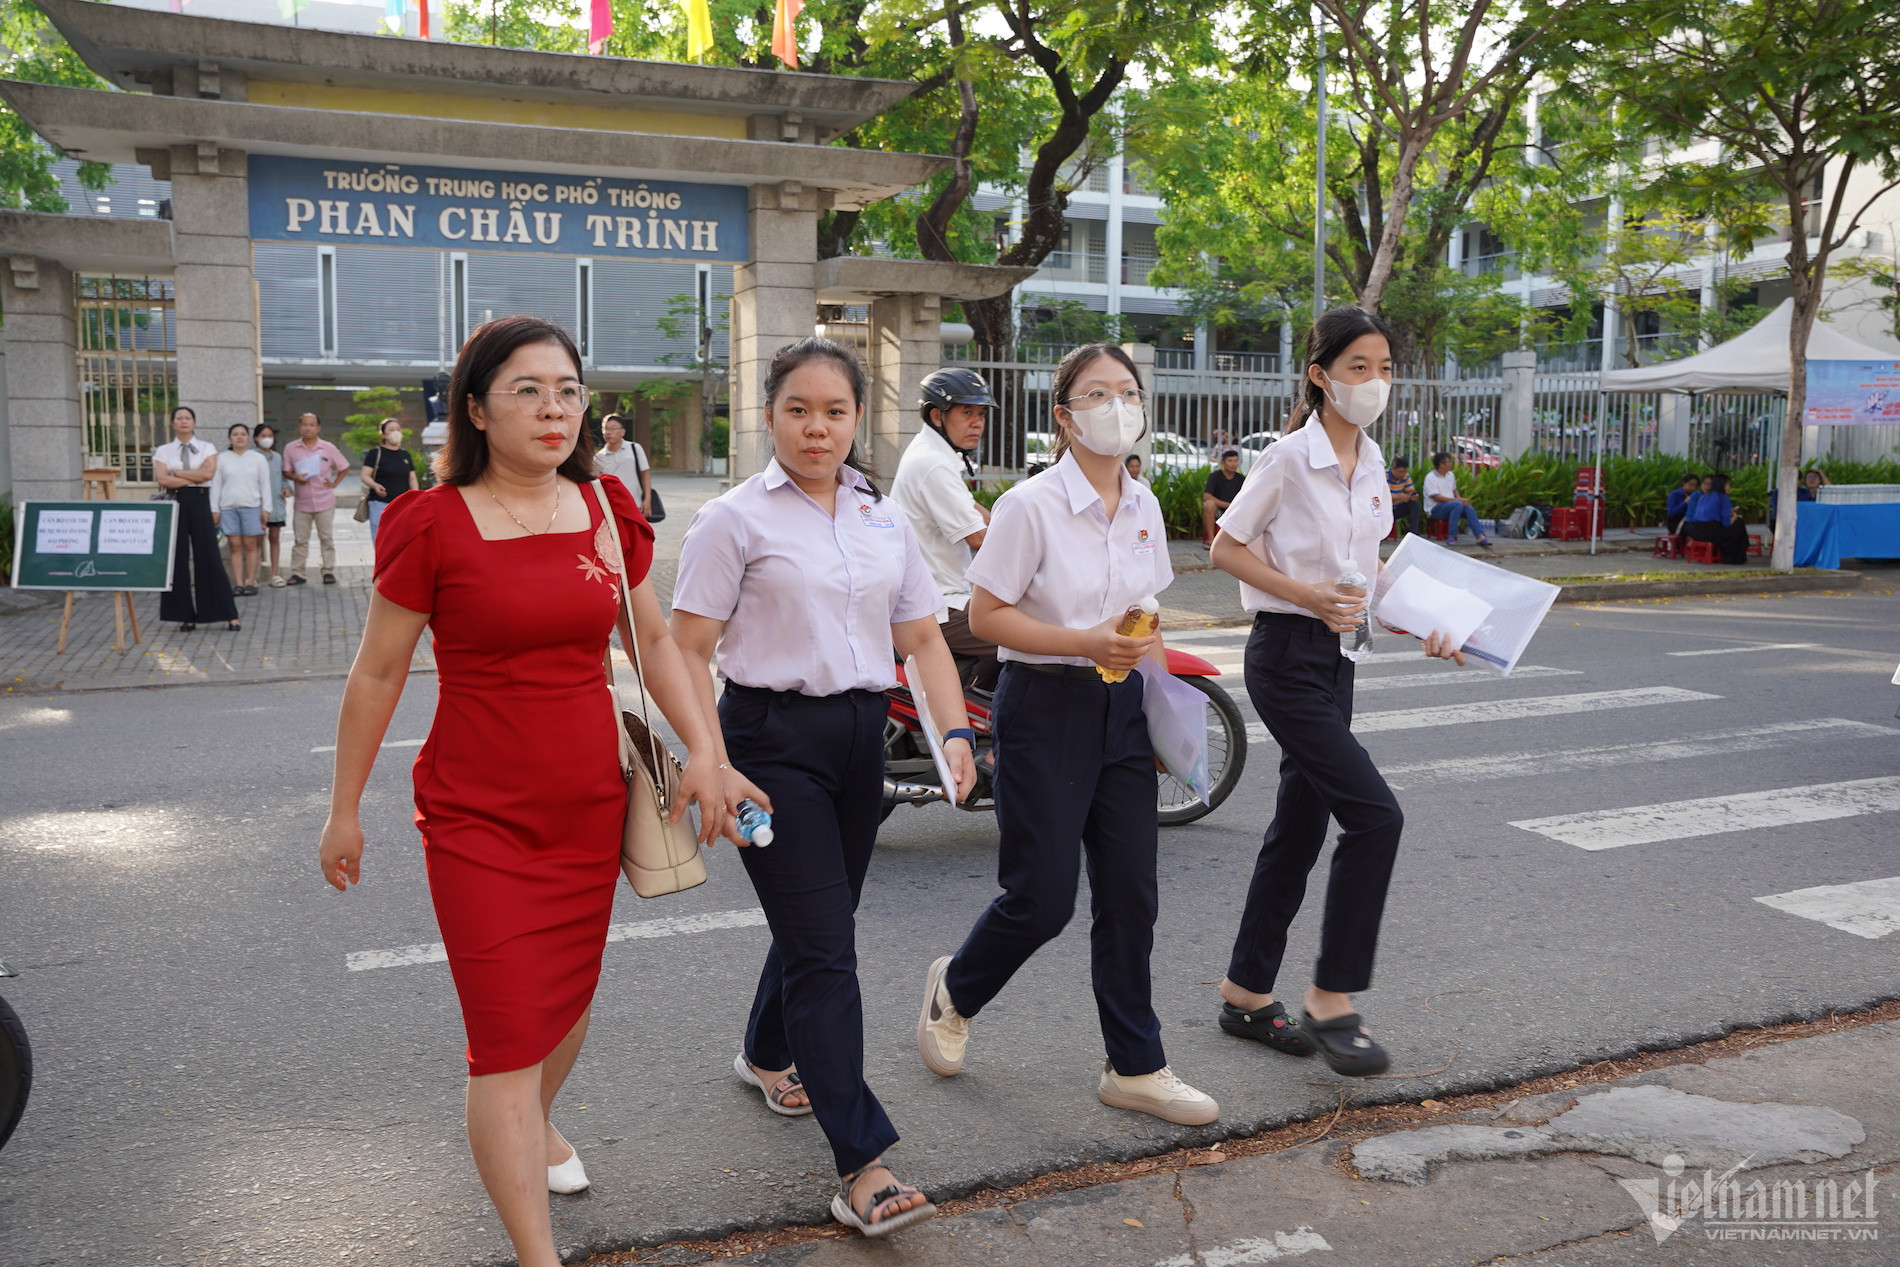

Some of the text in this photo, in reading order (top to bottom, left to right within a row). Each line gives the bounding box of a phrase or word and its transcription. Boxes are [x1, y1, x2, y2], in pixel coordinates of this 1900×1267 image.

[323, 165, 682, 210] TRƯỜNG TRUNG HỌC PHỔ THÔNG
[286, 198, 416, 238] PHAN
[439, 201, 563, 245] CHÂU
